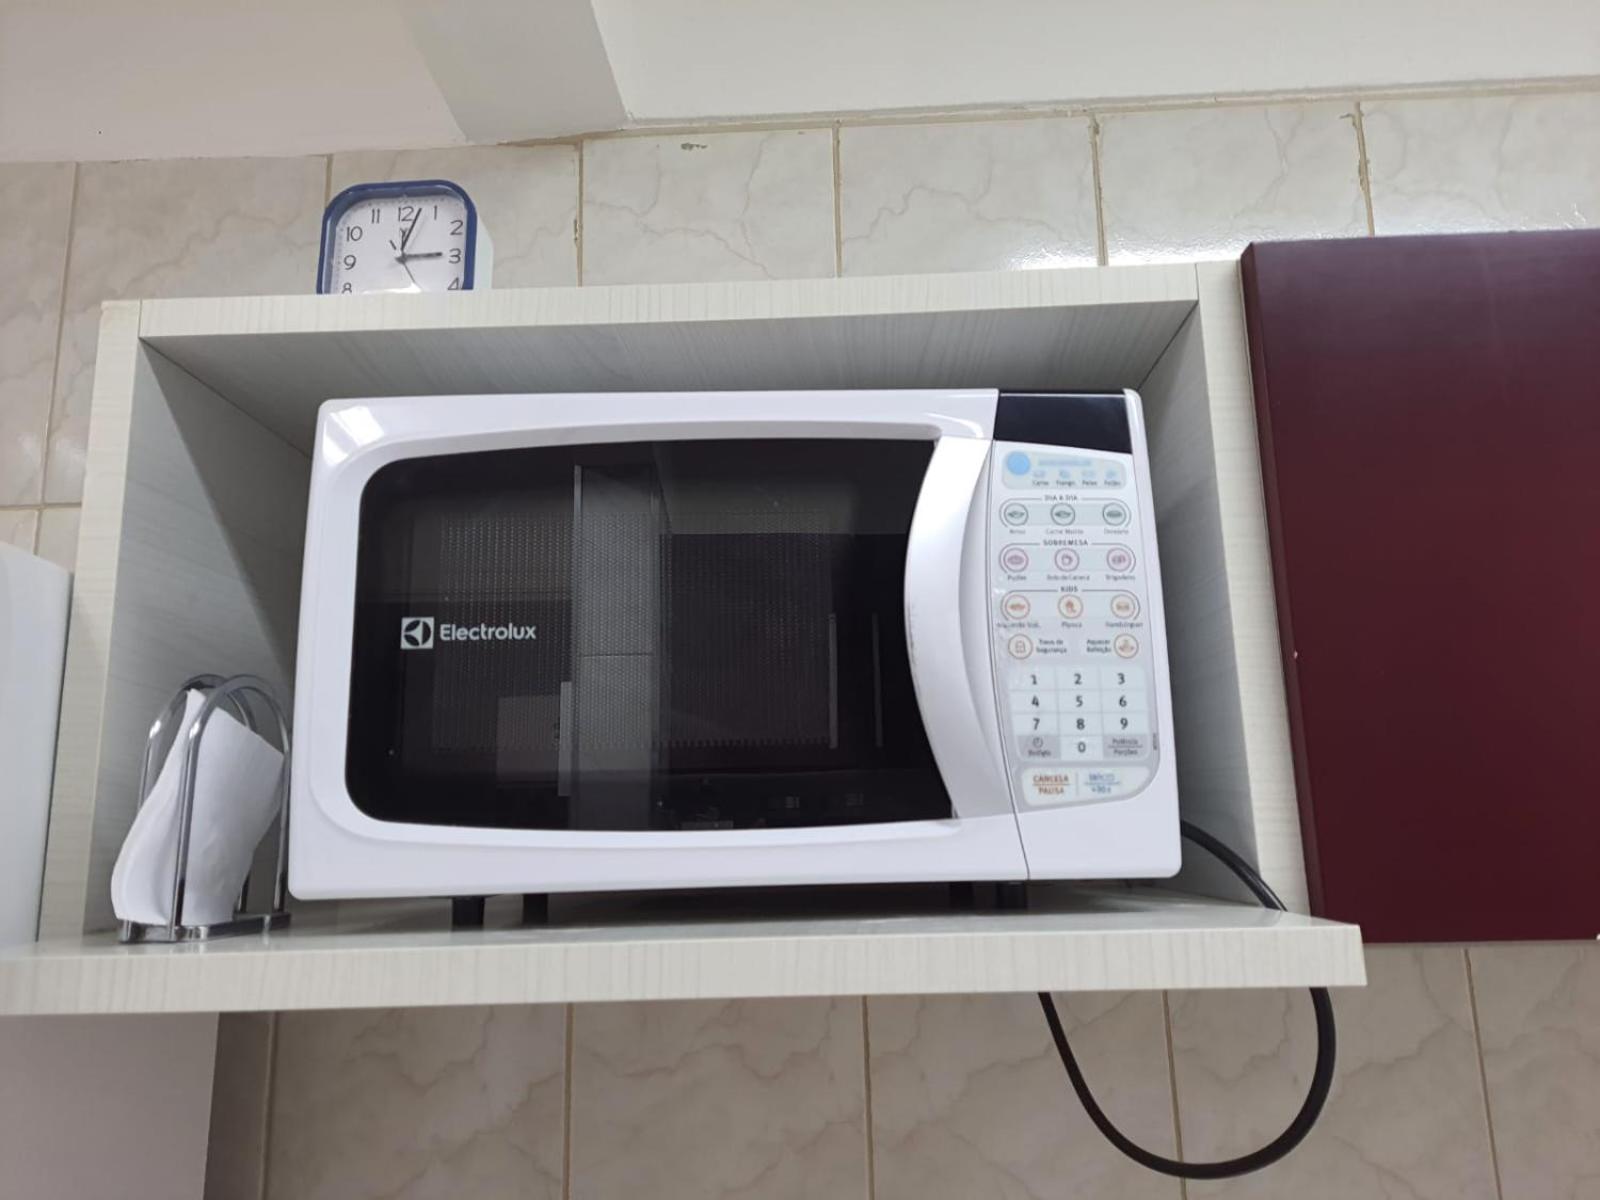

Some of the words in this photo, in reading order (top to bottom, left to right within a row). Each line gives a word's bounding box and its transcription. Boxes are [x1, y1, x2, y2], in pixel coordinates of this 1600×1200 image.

[371, 208, 380, 224] 11
[398, 206, 414, 222] 12
[433, 205, 438, 221] 1
[346, 226, 363, 241] 10
[450, 220, 463, 235] 2
[448, 248, 461, 264] 3
[343, 255, 356, 270] 9
[447, 277, 463, 290] 4
[440, 622, 537, 641] Electrolux
[1031, 674, 1037, 685] 1
[1074, 673, 1082, 685] 2
[1117, 673, 1125, 685] 3
[1032, 696, 1039, 707] 4
[1076, 695, 1083, 707] 5
[1119, 695, 1127, 707] 6
[1033, 718, 1040, 730] 7
[1076, 718, 1085, 730] 8
[1120, 718, 1128, 730] 9
[1077, 741, 1086, 753] 0
[1039, 786, 1064, 794] PAUSA
